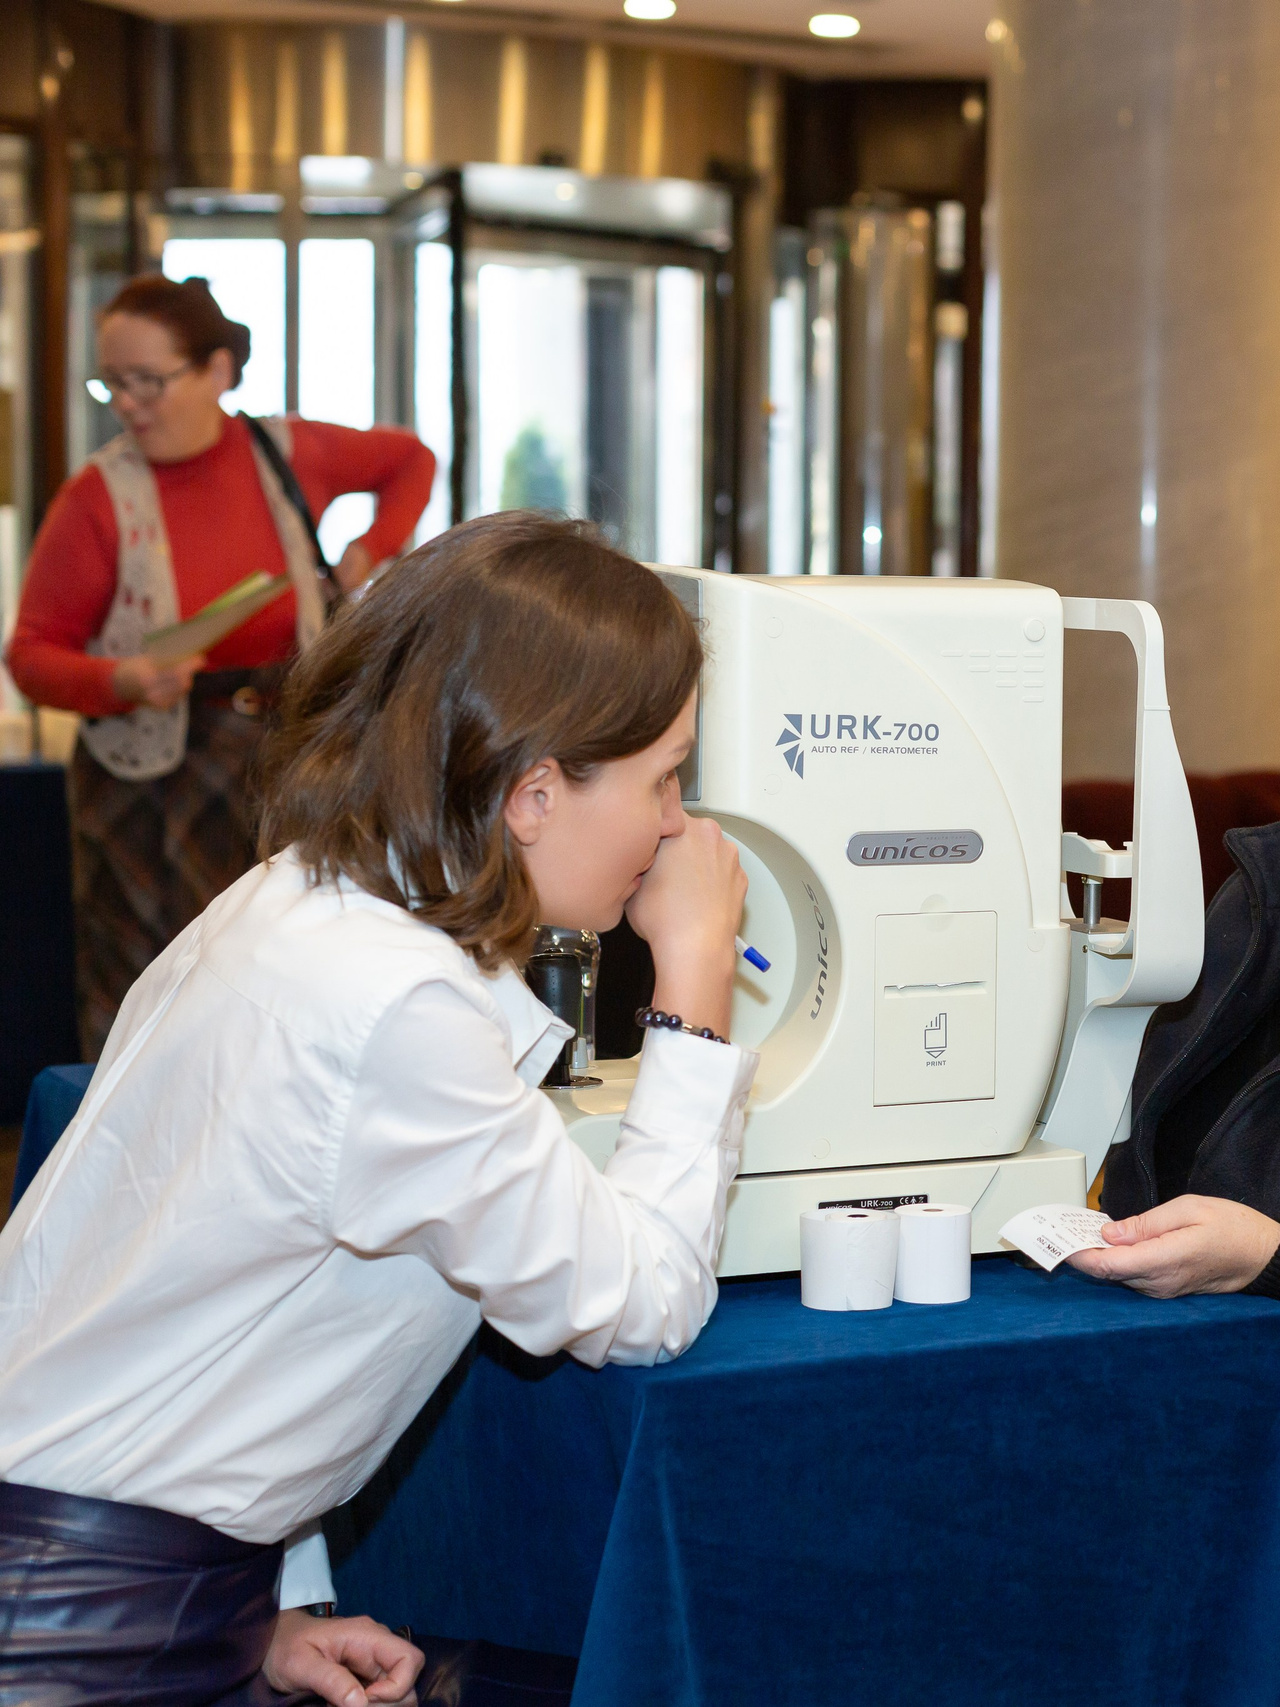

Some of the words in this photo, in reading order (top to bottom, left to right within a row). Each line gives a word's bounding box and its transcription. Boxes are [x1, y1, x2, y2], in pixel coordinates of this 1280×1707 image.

[810, 714, 940, 741] URK-700
[811, 746, 837, 754] AUTO
[840, 746, 859, 754] REF
[870, 746, 938, 755] KERATOMETER
[802, 880, 828, 1020] unicos
